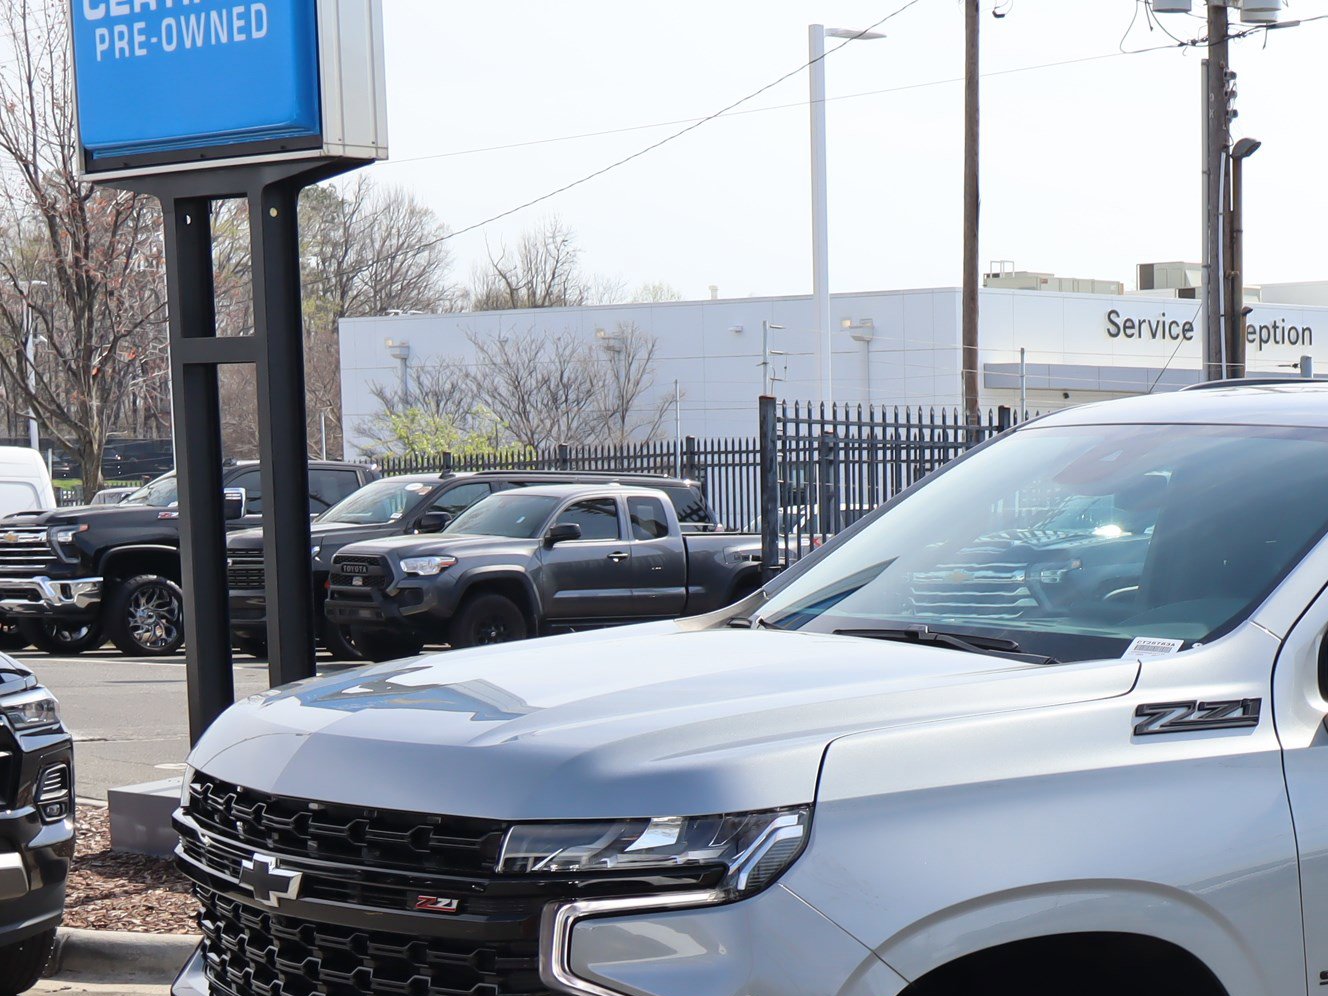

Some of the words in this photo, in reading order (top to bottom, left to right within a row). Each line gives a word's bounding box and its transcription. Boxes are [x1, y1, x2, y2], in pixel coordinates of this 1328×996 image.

[95, 3, 267, 61] PRE-OWNED
[1106, 310, 1194, 341] Service
[1245, 319, 1312, 350] eption
[343, 565, 367, 573] TOYOTA
[1134, 698, 1262, 735] Z71
[416, 895, 458, 912] Z71
